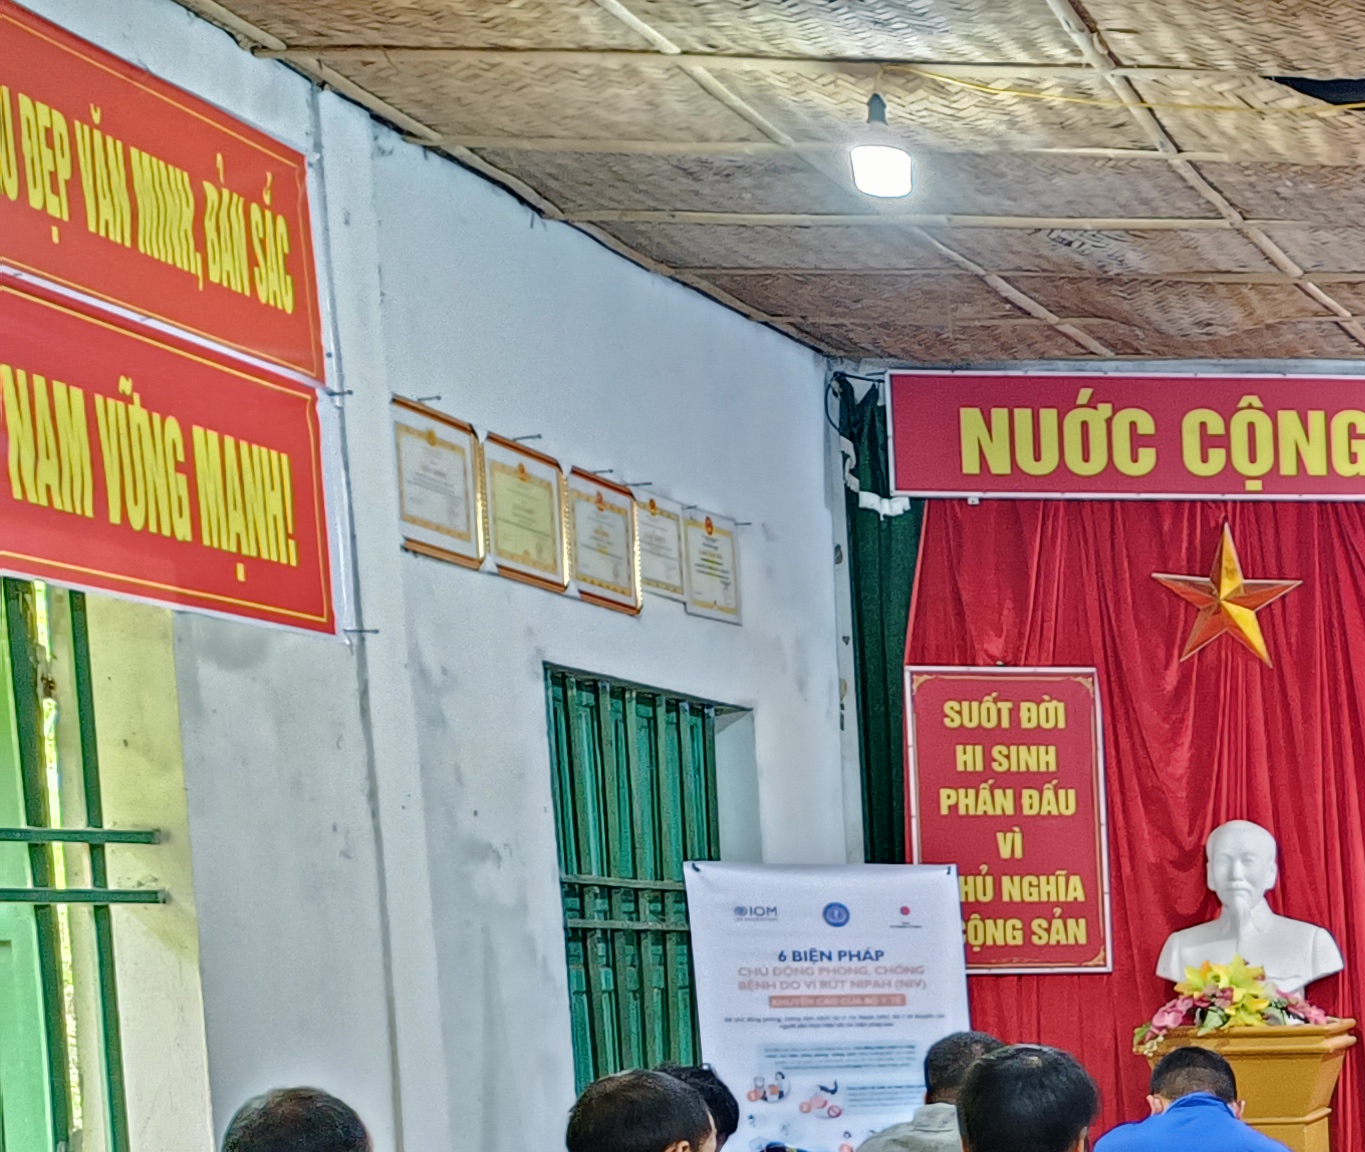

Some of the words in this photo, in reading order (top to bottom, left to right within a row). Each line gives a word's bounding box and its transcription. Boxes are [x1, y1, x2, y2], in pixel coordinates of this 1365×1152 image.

[0, 85, 19, 201] U
[18, 92, 72, 244] ĐẸP
[74, 103, 132, 249] VĂN
[202, 152, 251, 297] BẢN
[250, 171, 294, 314] SẮC
[0, 363, 94, 518] NAM
[94, 375, 193, 542] VỮNG
[192, 424, 298, 582] MẠNH!
[943, 691, 1014, 729] SUỐT
[1019, 694, 1067, 730] ĐỜI
[955, 744, 985, 772] HI
[991, 744, 1058, 772] SINH
[939, 778, 1015, 816] PHẤN
[1021, 778, 1077, 816] ĐẤU
[996, 825, 1024, 860] VÌ
[959, 864, 994, 902] HỦ
[1001, 870, 1086, 902] NGHĨA
[749, 906, 778, 916] IOM
[962, 912, 1024, 952] ỘNG
[1031, 906, 1088, 946] SẢN
[778, 950, 787, 962] 6
[792, 947, 833, 964] BIỆN
[838, 947, 885, 962] PHÁP
